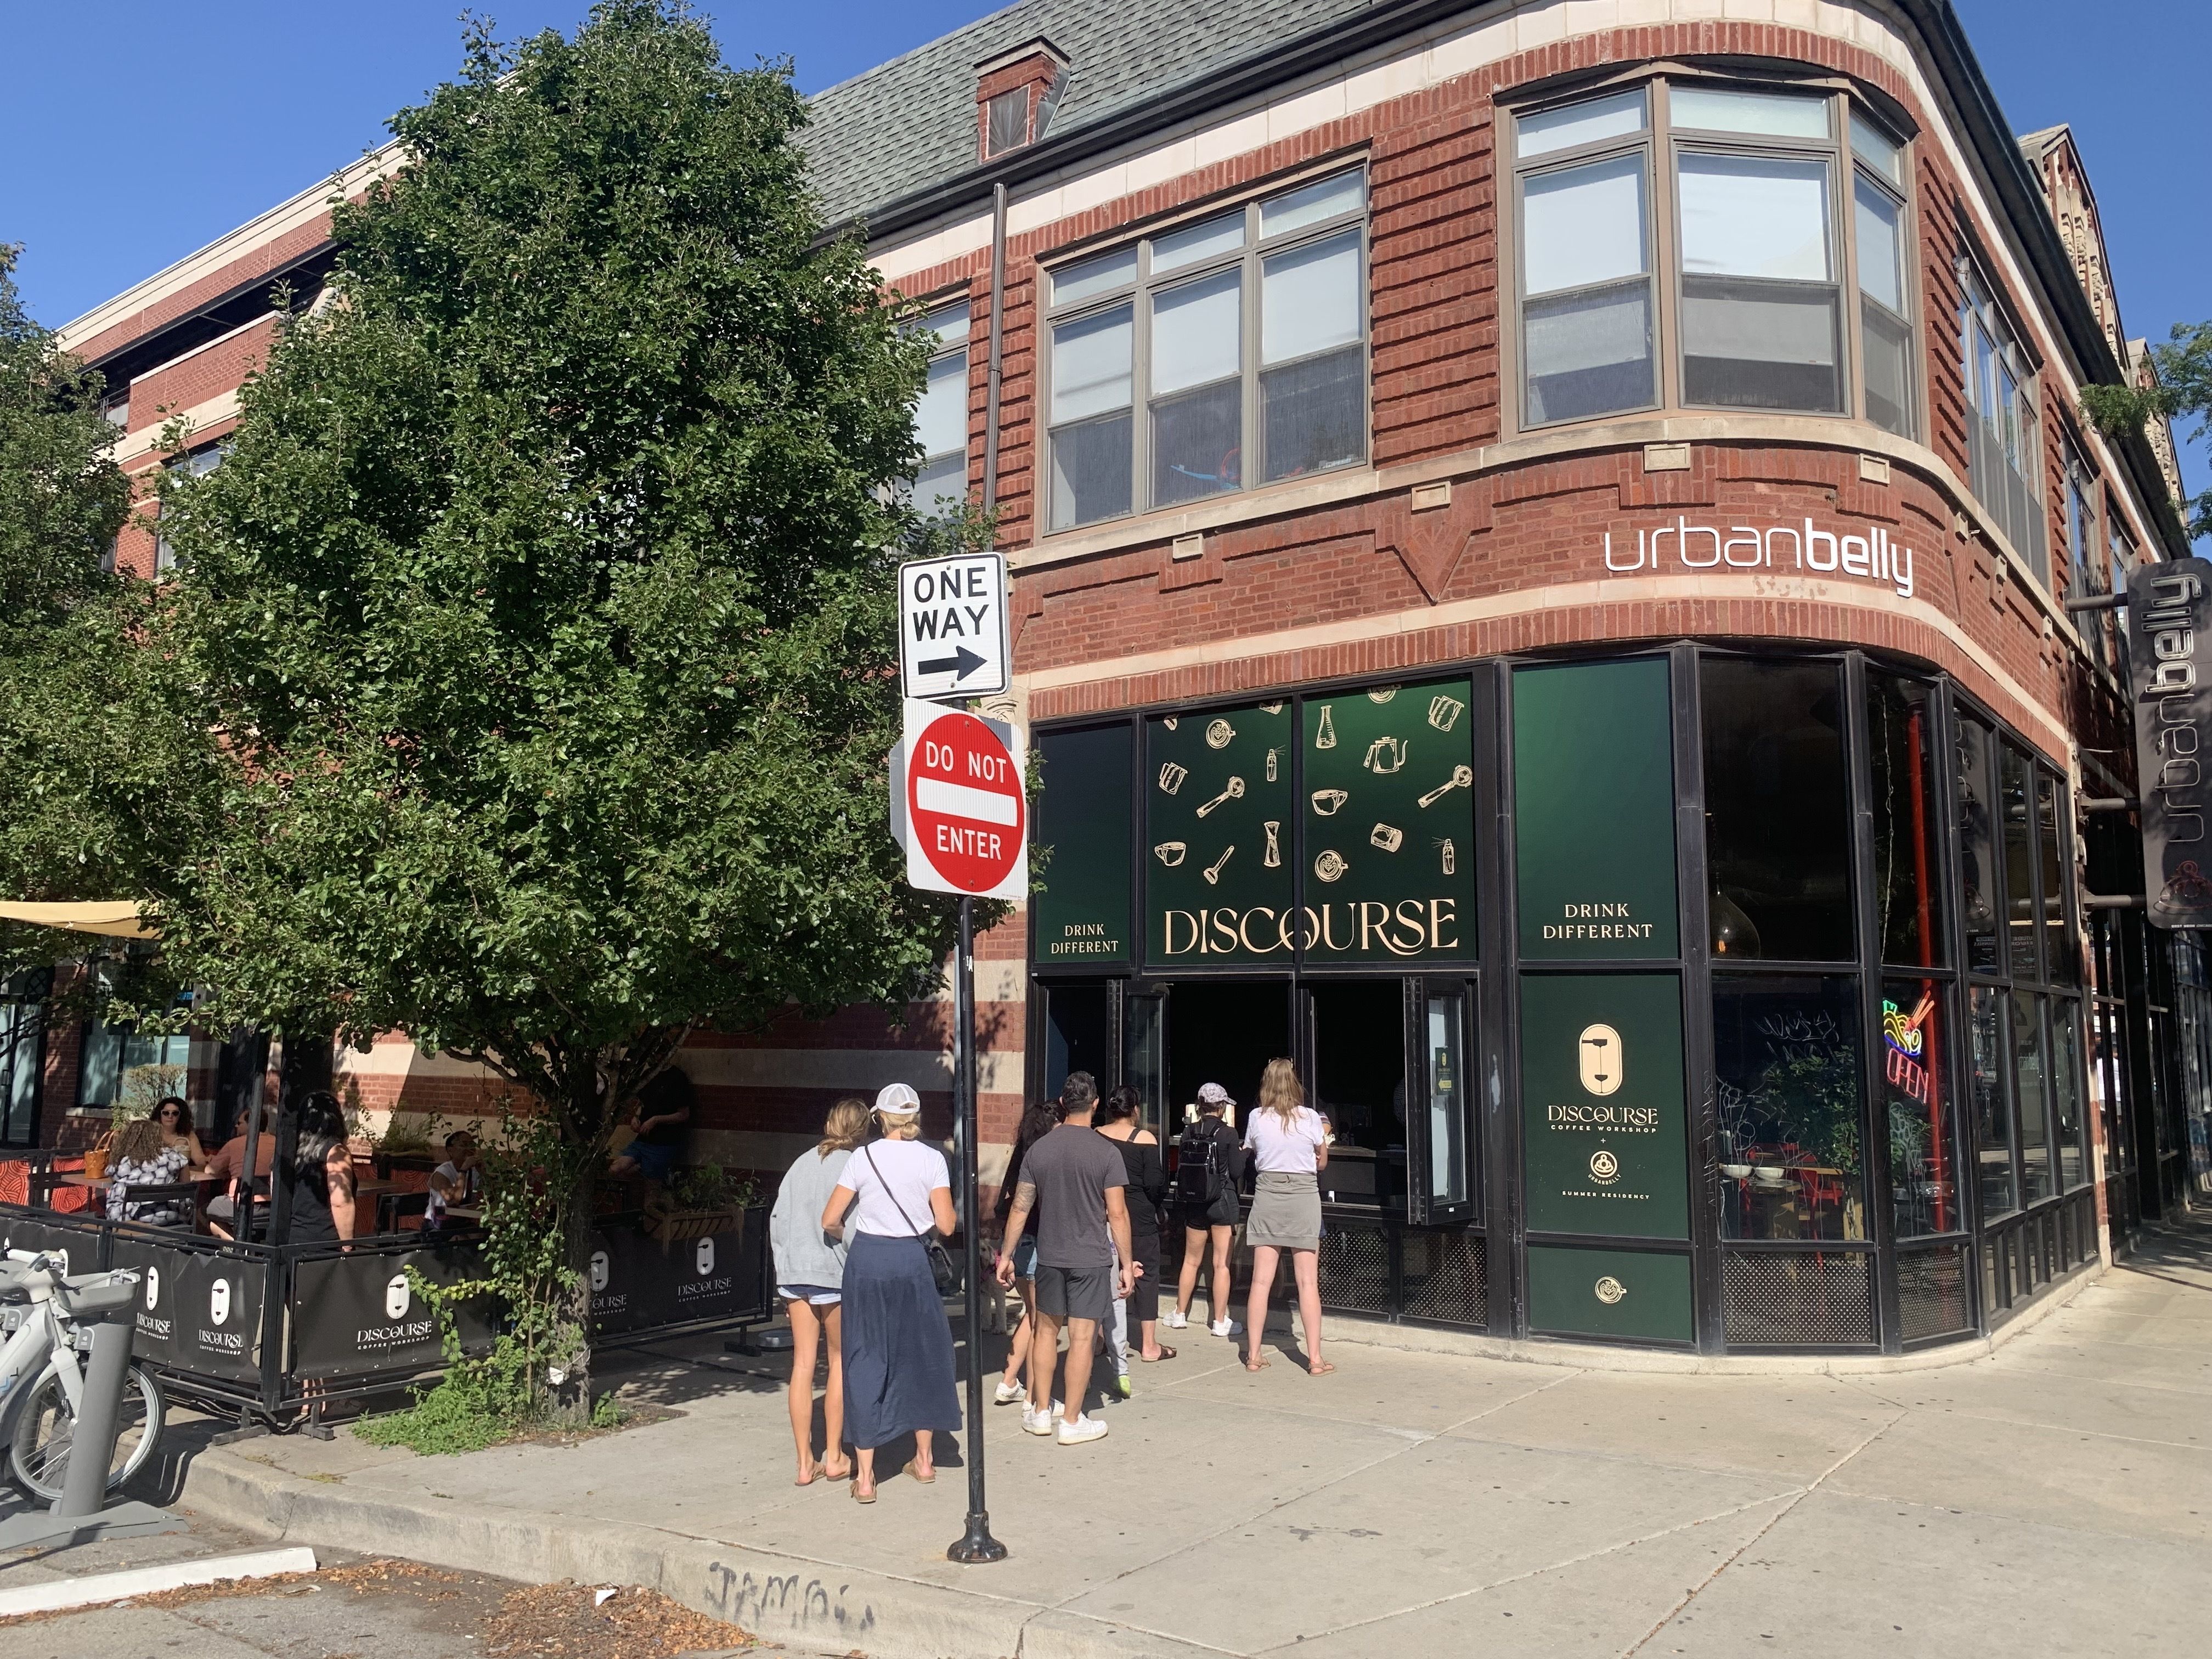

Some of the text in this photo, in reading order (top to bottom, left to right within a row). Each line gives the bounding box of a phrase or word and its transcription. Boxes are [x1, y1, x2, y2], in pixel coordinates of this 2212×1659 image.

[1604, 515, 1914, 598] urbanbelly
[914, 566, 988, 603] ONE
[913, 604, 990, 642] WAY
[2141, 573, 2205, 843] urbanbelly
[926, 741, 1007, 784] DO NOT
[936, 825, 1002, 860] ENTER
[1565, 903, 1629, 918] DRINK
[1064, 923, 1104, 937] DRINK
[1165, 898, 1458, 956] DISCOURSE
[1543, 923, 1653, 939] DIFFERENT
[1050, 940, 1119, 955] DIFFERENT
[1887, 1048, 1929, 1104] OPEN
[1548, 1105, 1658, 1126] DISCOURSE
[1588, 1173, 1622, 1185] URBANBELLY
[678, 1277, 732, 1296] DISCOURSE
[592, 1294, 627, 1310] OURSE
[137, 1312, 171, 1334] DISCOURSE
[357, 1320, 432, 1343] DISCOURSE
[357, 1335, 430, 1350] COFFEE WORKSHOP
